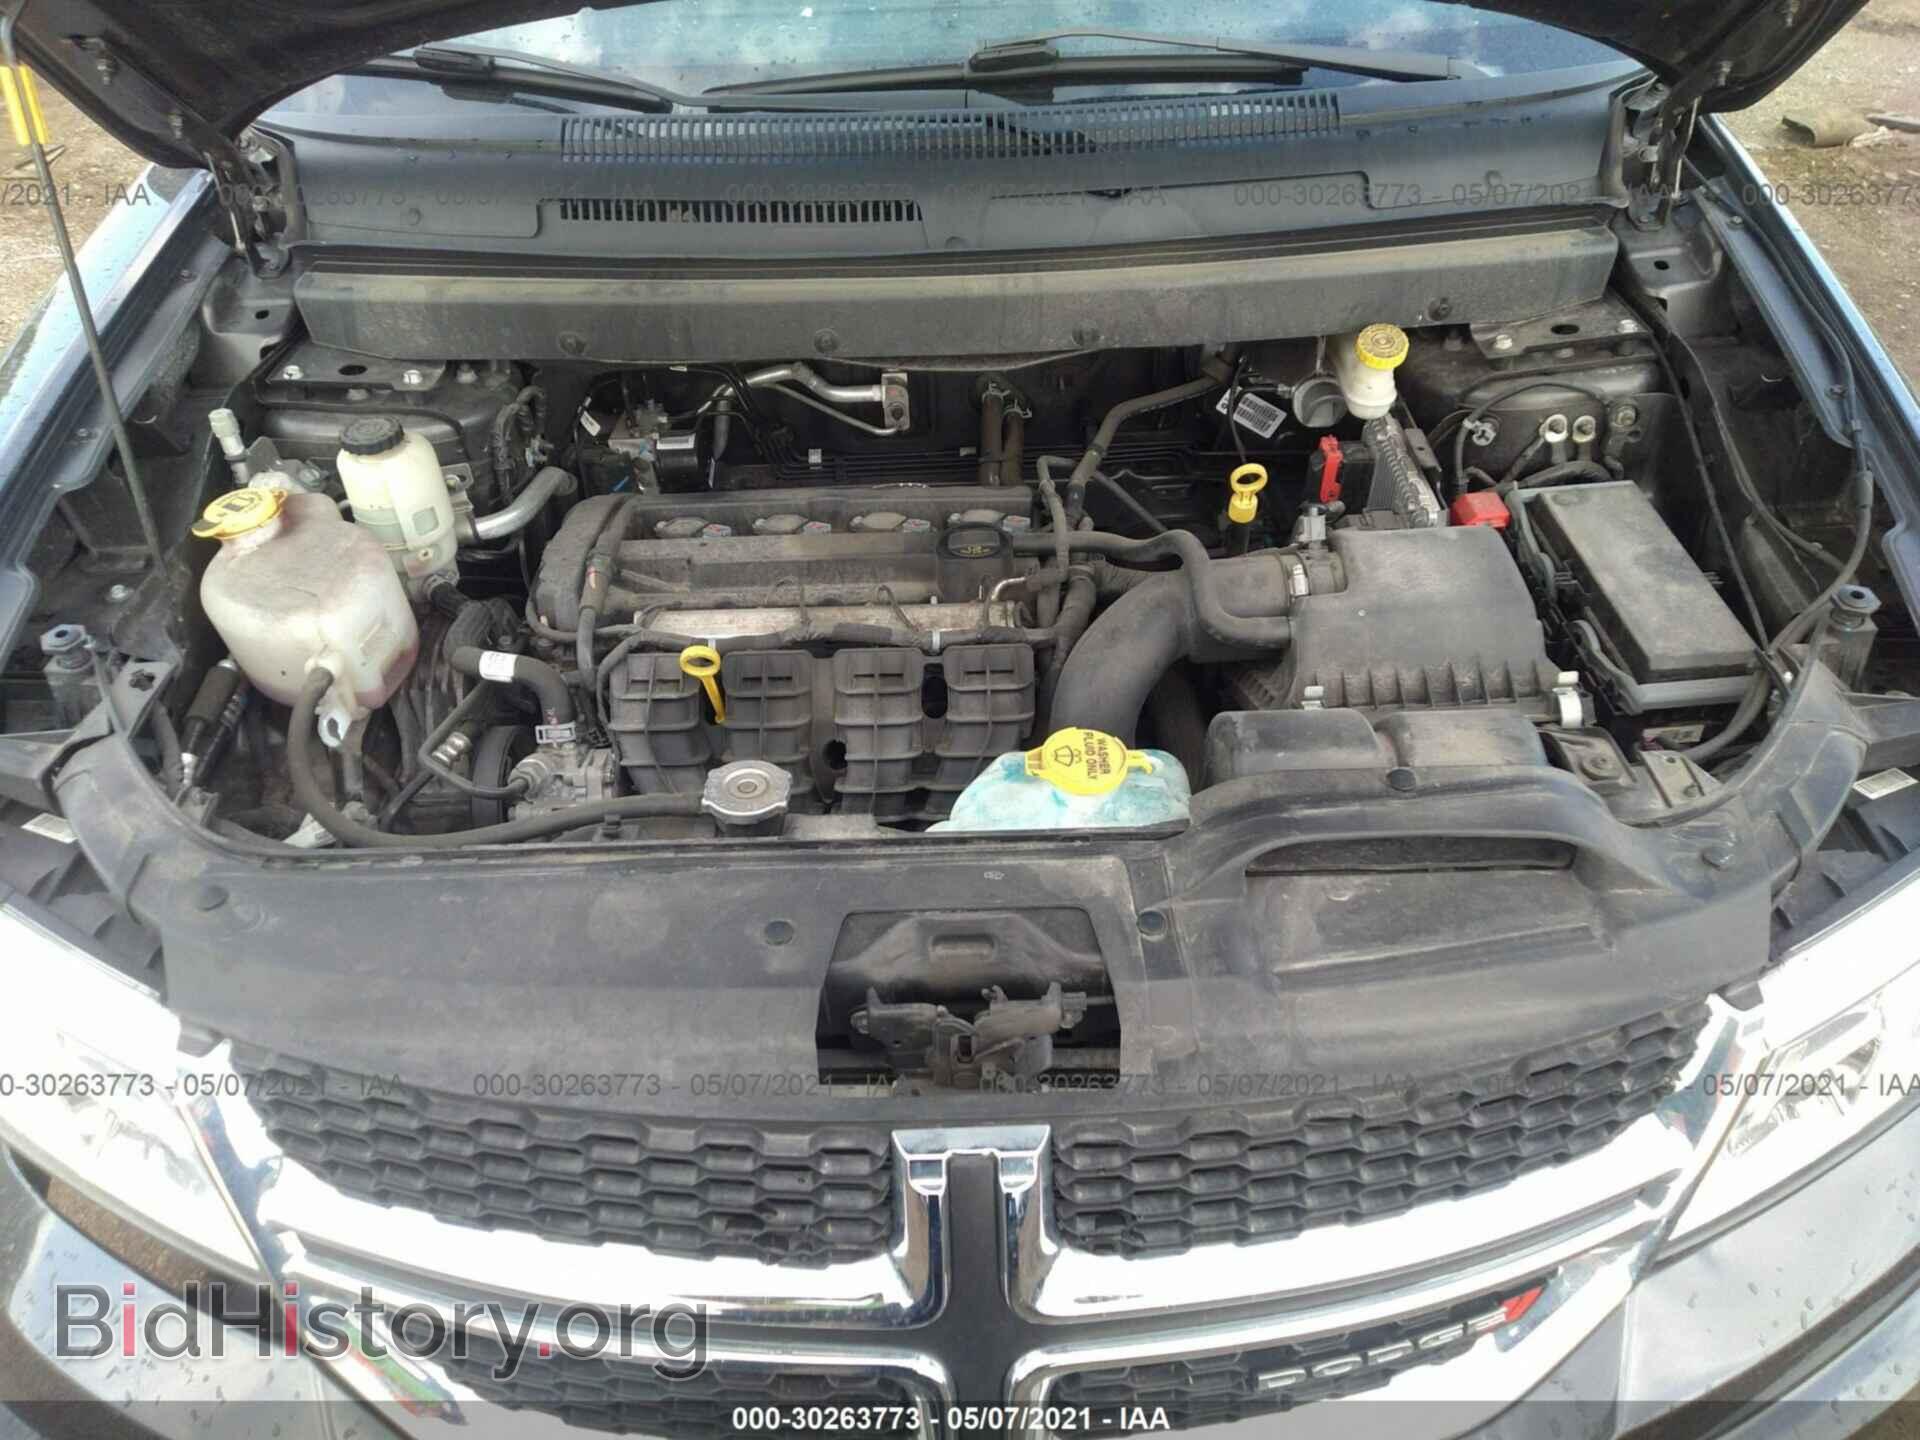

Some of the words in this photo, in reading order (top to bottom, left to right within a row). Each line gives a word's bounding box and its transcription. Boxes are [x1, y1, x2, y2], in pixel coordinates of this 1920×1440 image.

[1083, 731, 1096, 756] FLUID
[1097, 738, 1111, 774] WASHER
[1086, 758, 1097, 779] ONLY
